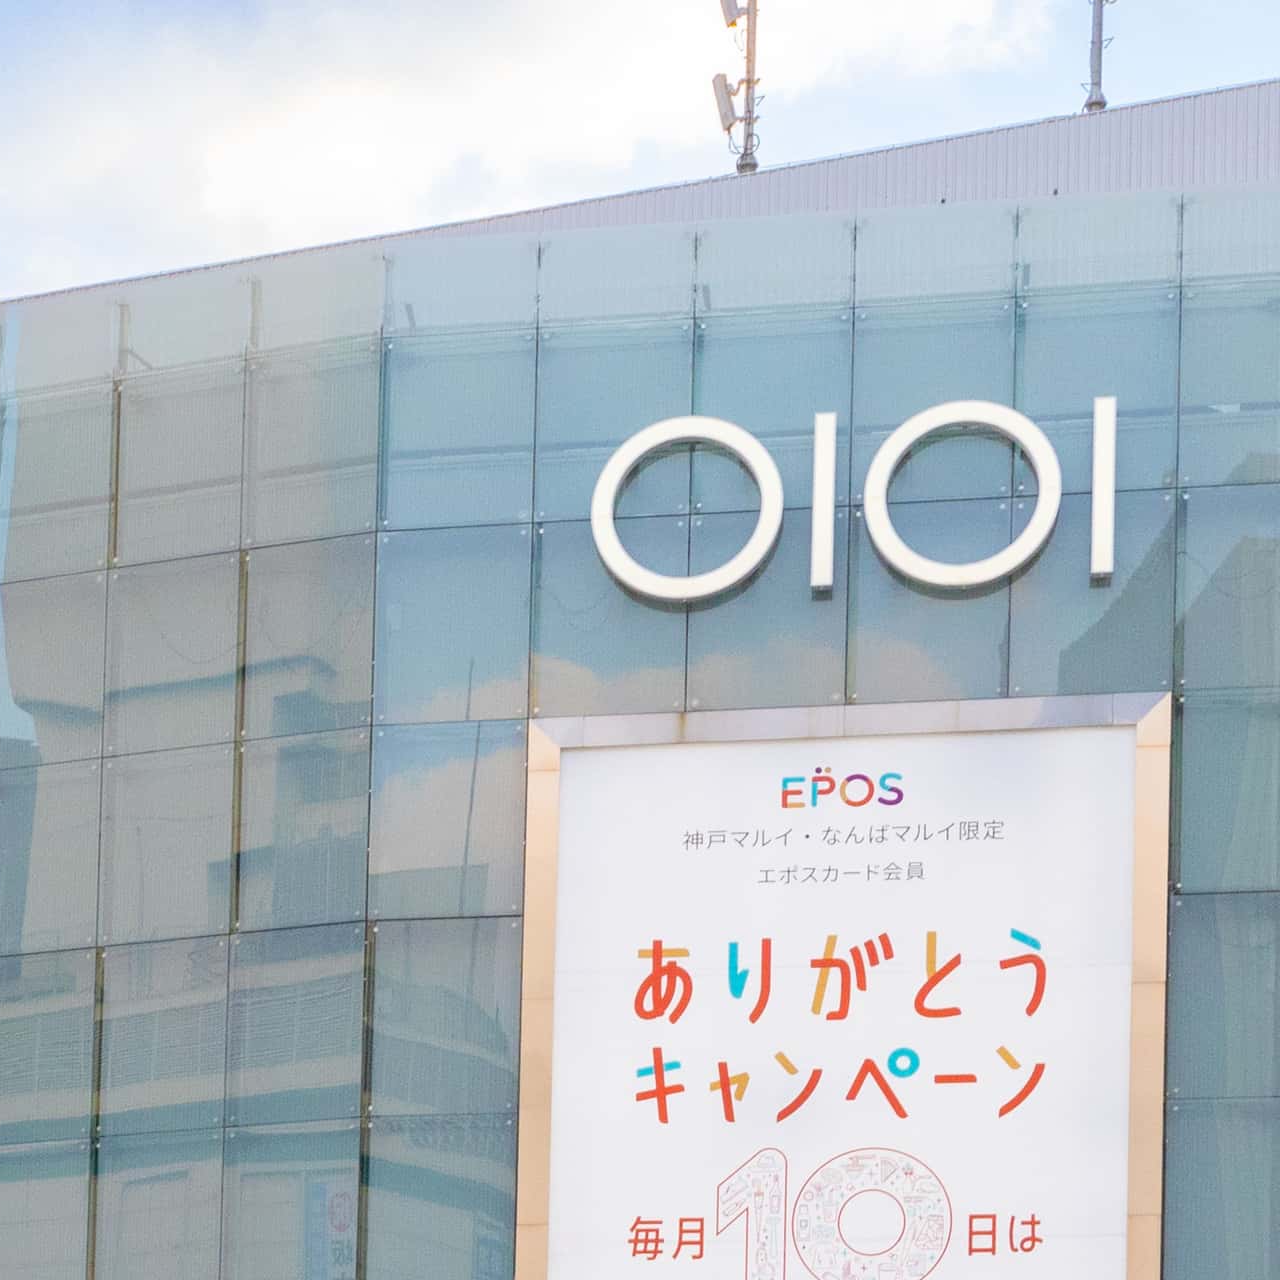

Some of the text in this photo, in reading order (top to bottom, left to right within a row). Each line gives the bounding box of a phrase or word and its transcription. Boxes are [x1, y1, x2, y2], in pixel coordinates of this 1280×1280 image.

[781, 767, 904, 808] EPOS
[683, 819, 1005, 851] 神戸マルイ・なんばマルイ限定
[758, 861, 925, 885] エポスカード会員
[634, 928, 1047, 1024] ありがとう
[636, 1047, 1046, 1123] キャンペーン
